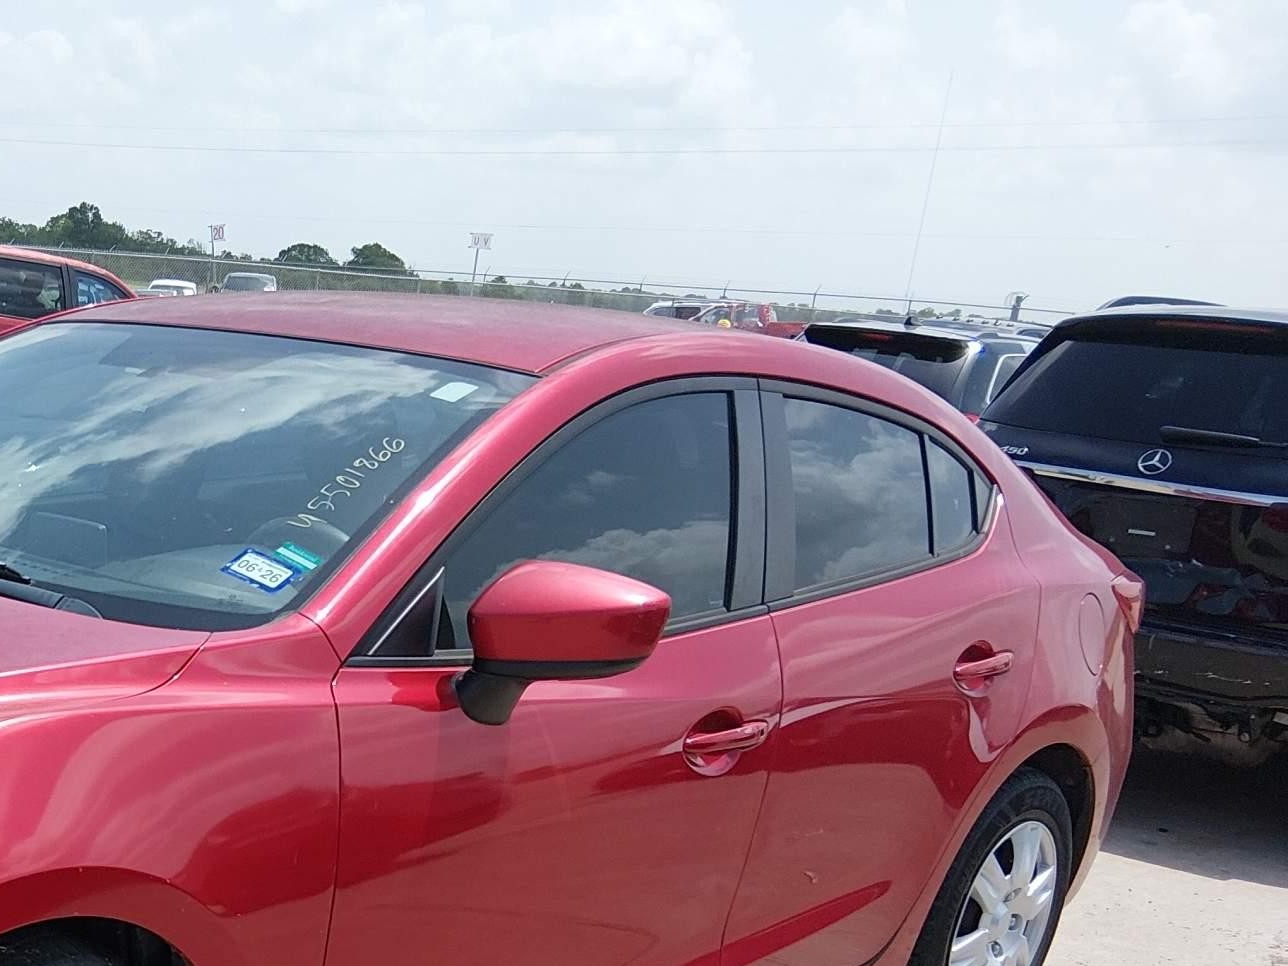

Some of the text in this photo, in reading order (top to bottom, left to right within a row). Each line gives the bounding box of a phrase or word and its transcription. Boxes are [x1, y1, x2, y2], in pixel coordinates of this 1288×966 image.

[213, 226, 224, 240] 20
[473, 236, 480, 246] U
[287, 437, 405, 528] 45501866
[236, 559, 259, 573] 06
[259, 569, 283, 583] 26
